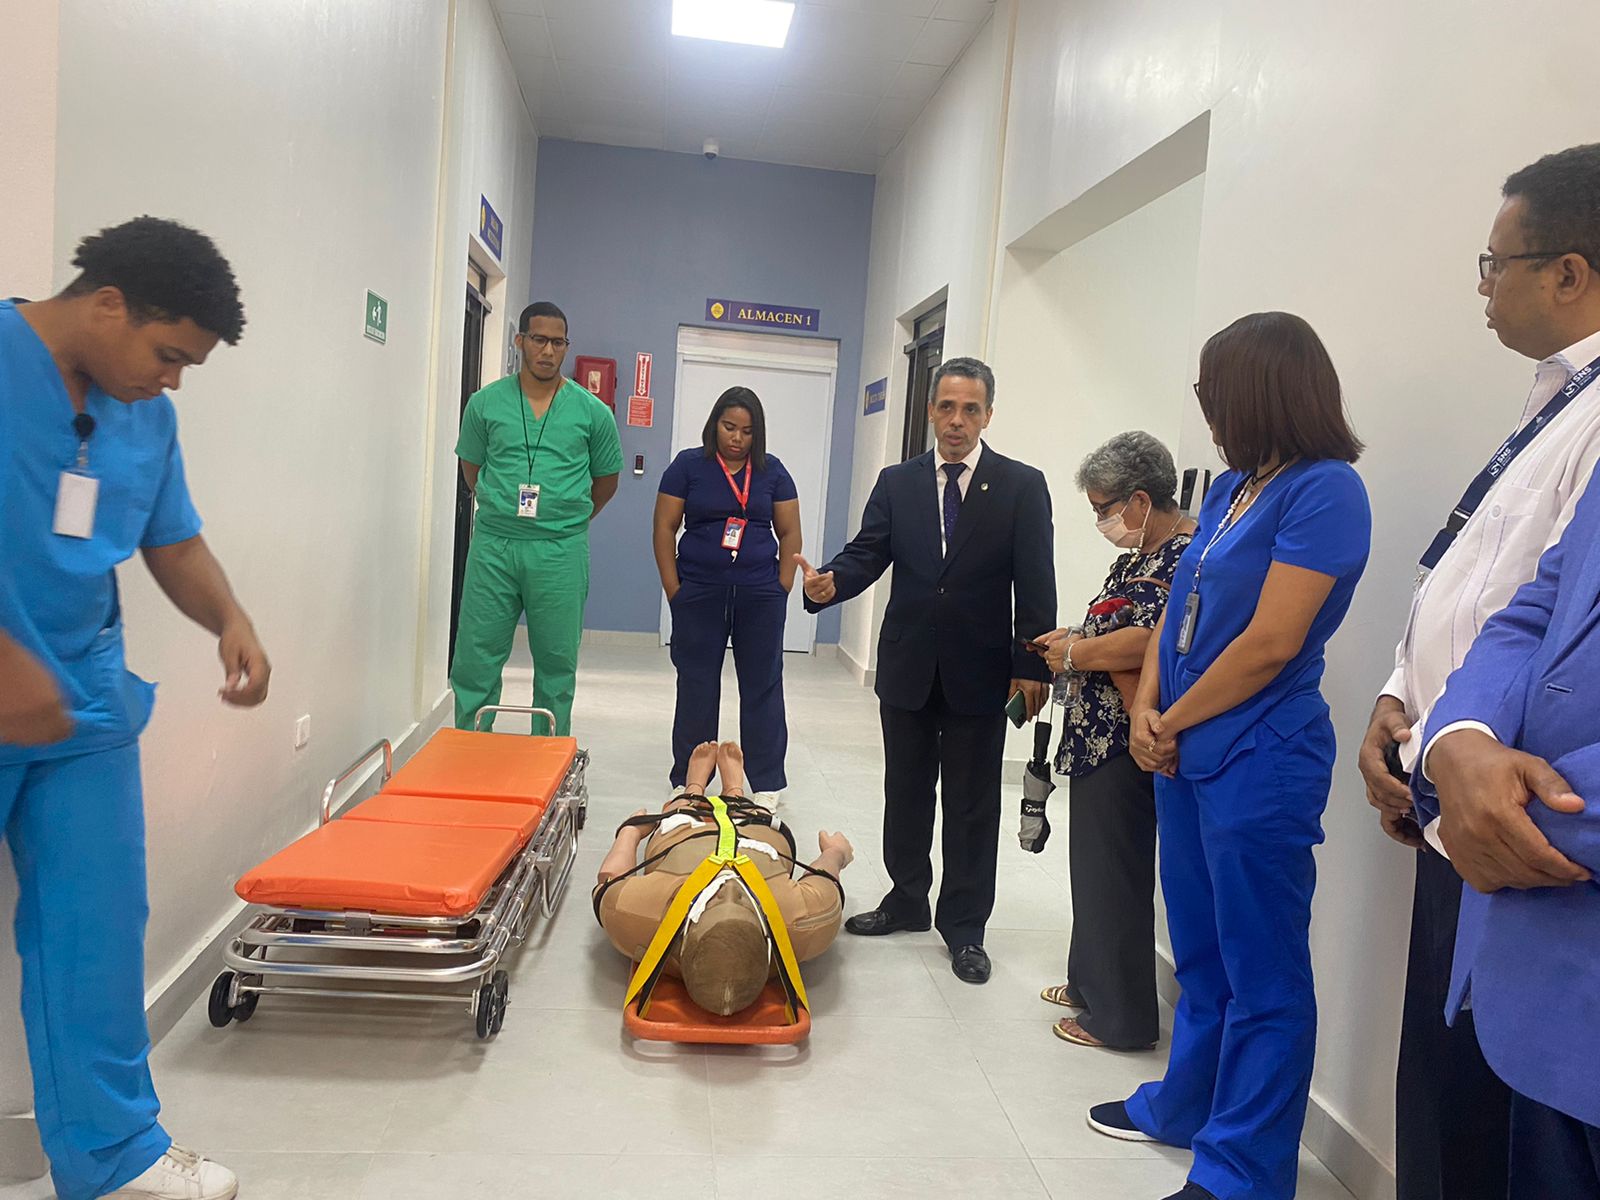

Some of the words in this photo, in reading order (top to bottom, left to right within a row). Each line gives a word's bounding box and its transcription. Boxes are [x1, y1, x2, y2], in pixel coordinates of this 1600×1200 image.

[738, 308, 802, 325] ALMACEN
[806, 315, 811, 326] 1
[1573, 366, 1592, 383] SNS
[1497, 447, 1511, 463] SNS
